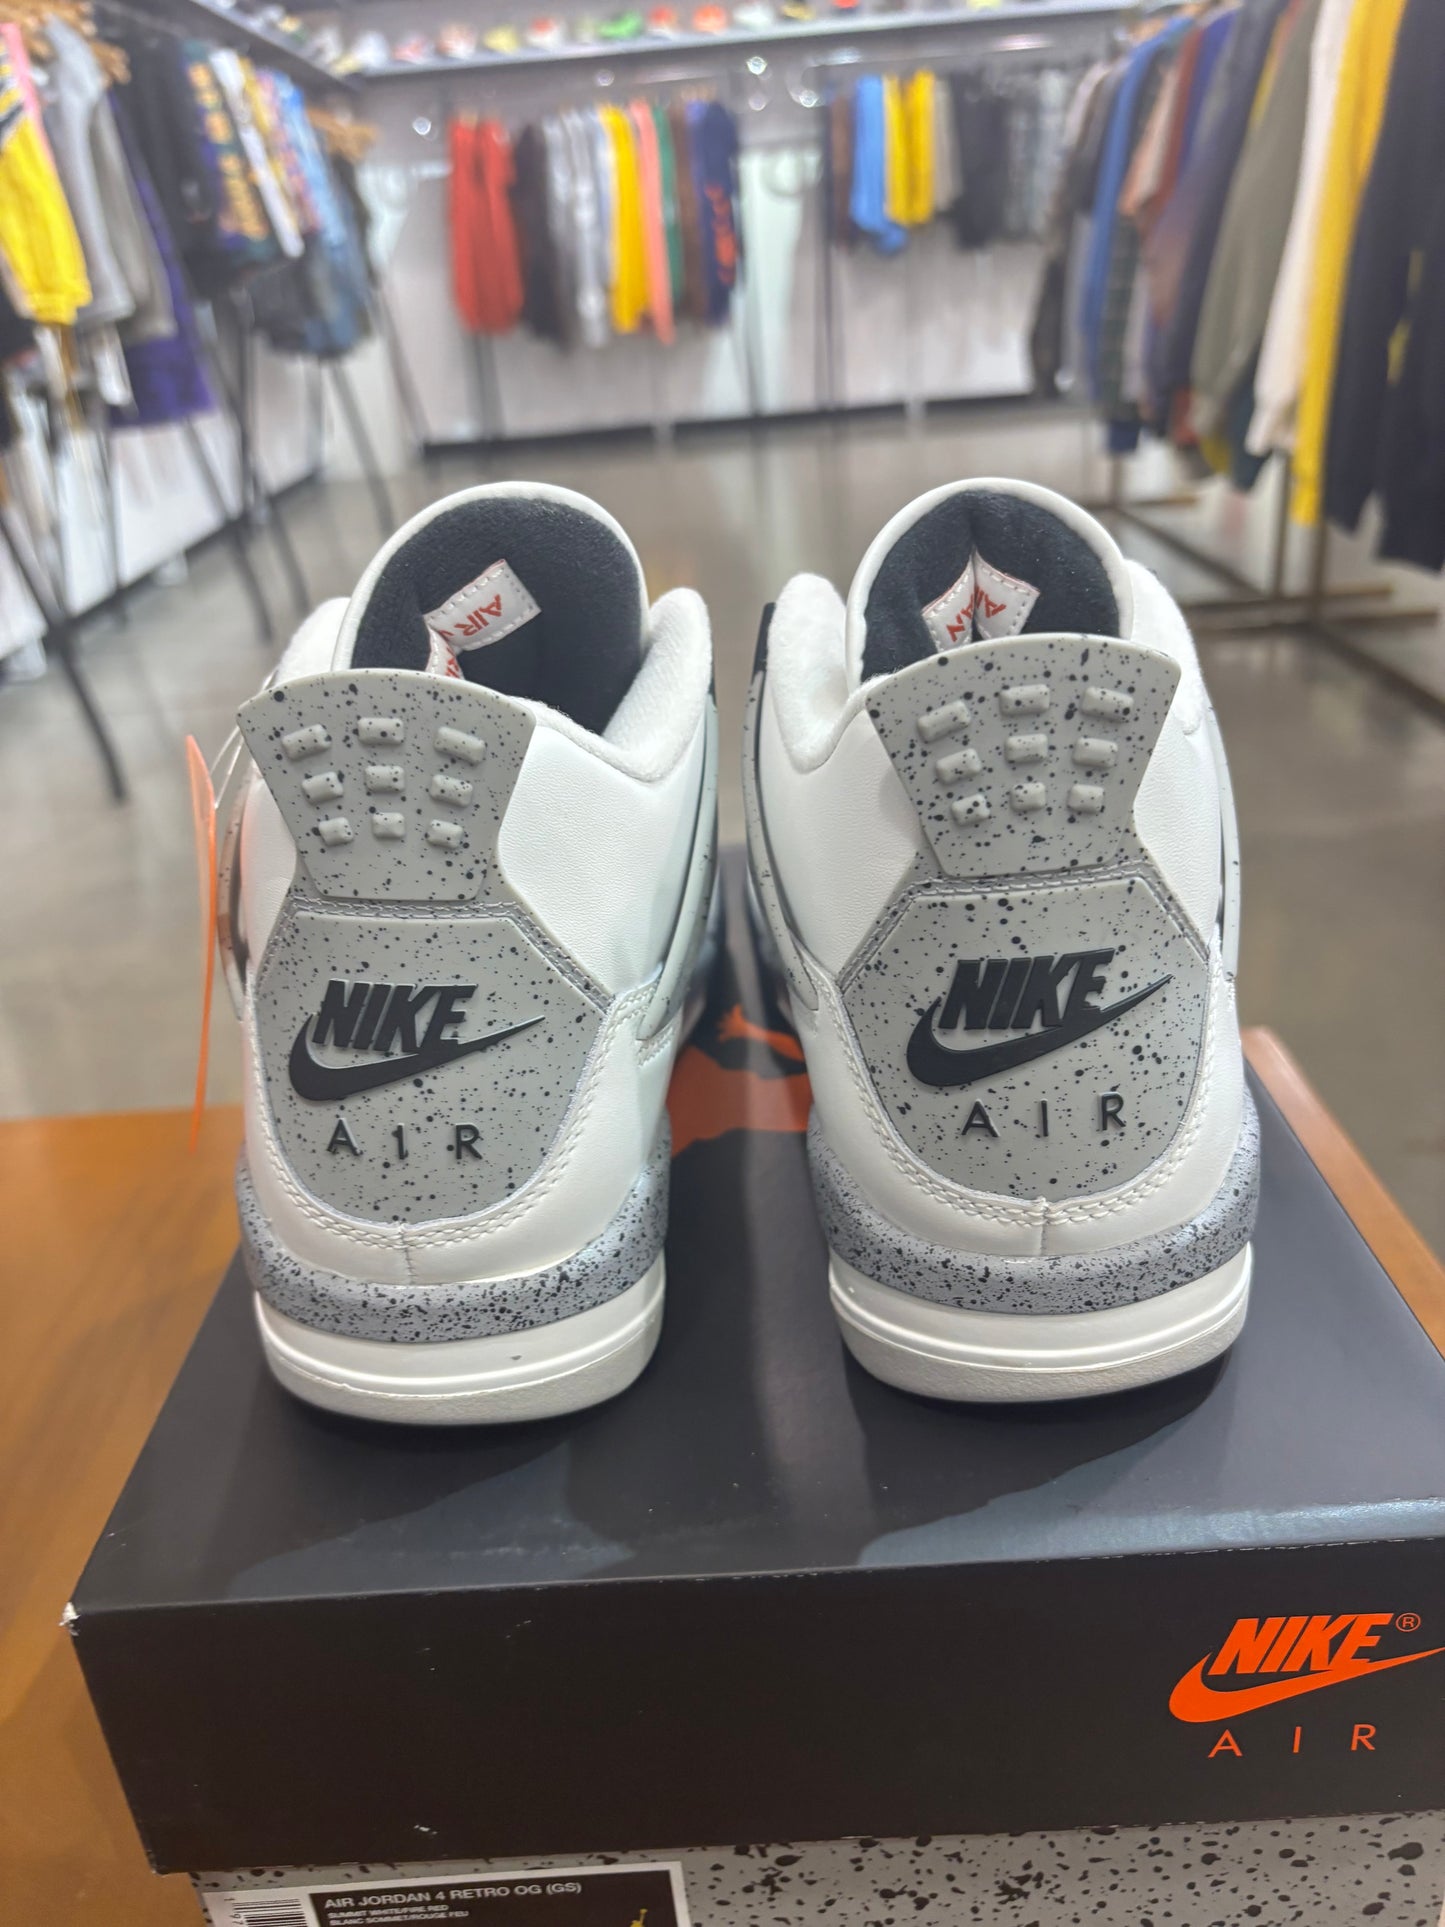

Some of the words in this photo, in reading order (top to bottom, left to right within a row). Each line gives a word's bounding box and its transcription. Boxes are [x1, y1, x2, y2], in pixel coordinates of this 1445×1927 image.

[454, 594, 502, 636] AIR
[938, 948, 1116, 1030] NIKE
[312, 980, 478, 1053] NIKE
[961, 1091, 1127, 1138] AIR
[327, 1117, 483, 1160] AIR
[1207, 1613, 1394, 1676] NIKE
[1208, 1723, 1377, 1758] AIR
[324, 1897, 354, 1908] AIR
[358, 1892, 431, 1906] JORDAN
[435, 1891, 446, 1900] 4
[450, 1886, 511, 1900] RETRO
[514, 1884, 542, 1895] OG
[546, 1882, 582, 1895] (GS)
